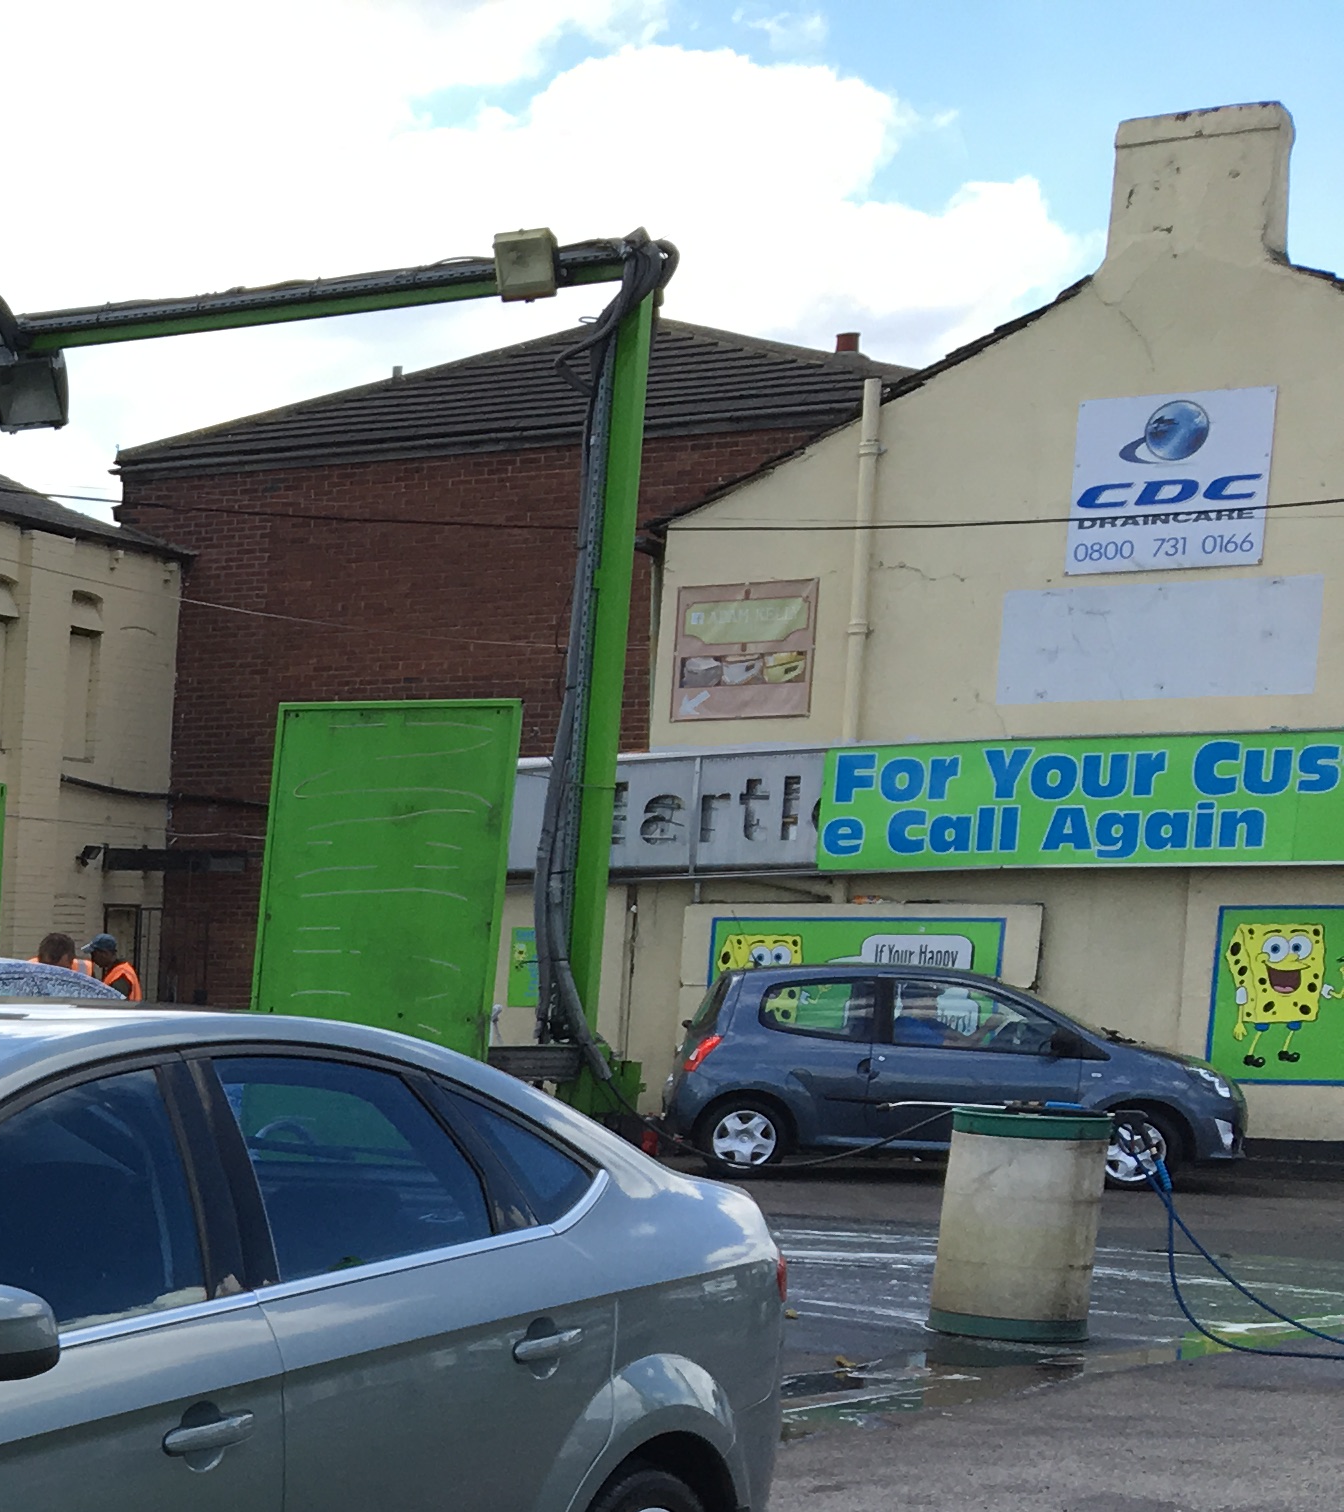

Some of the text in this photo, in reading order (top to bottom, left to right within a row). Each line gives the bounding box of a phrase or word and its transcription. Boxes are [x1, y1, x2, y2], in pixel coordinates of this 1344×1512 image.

[1076, 473, 1263, 508] CDC
[1077, 508, 1256, 530] DRAINCARE
[1073, 532, 1254, 563] 0800 731 0166
[834, 748, 961, 804] For
[983, 747, 1168, 801] Your
[886, 804, 1021, 856] Call
[1040, 800, 1267, 859] Again
[875, 944, 885, 963] If
[887, 944, 914, 964] Your
